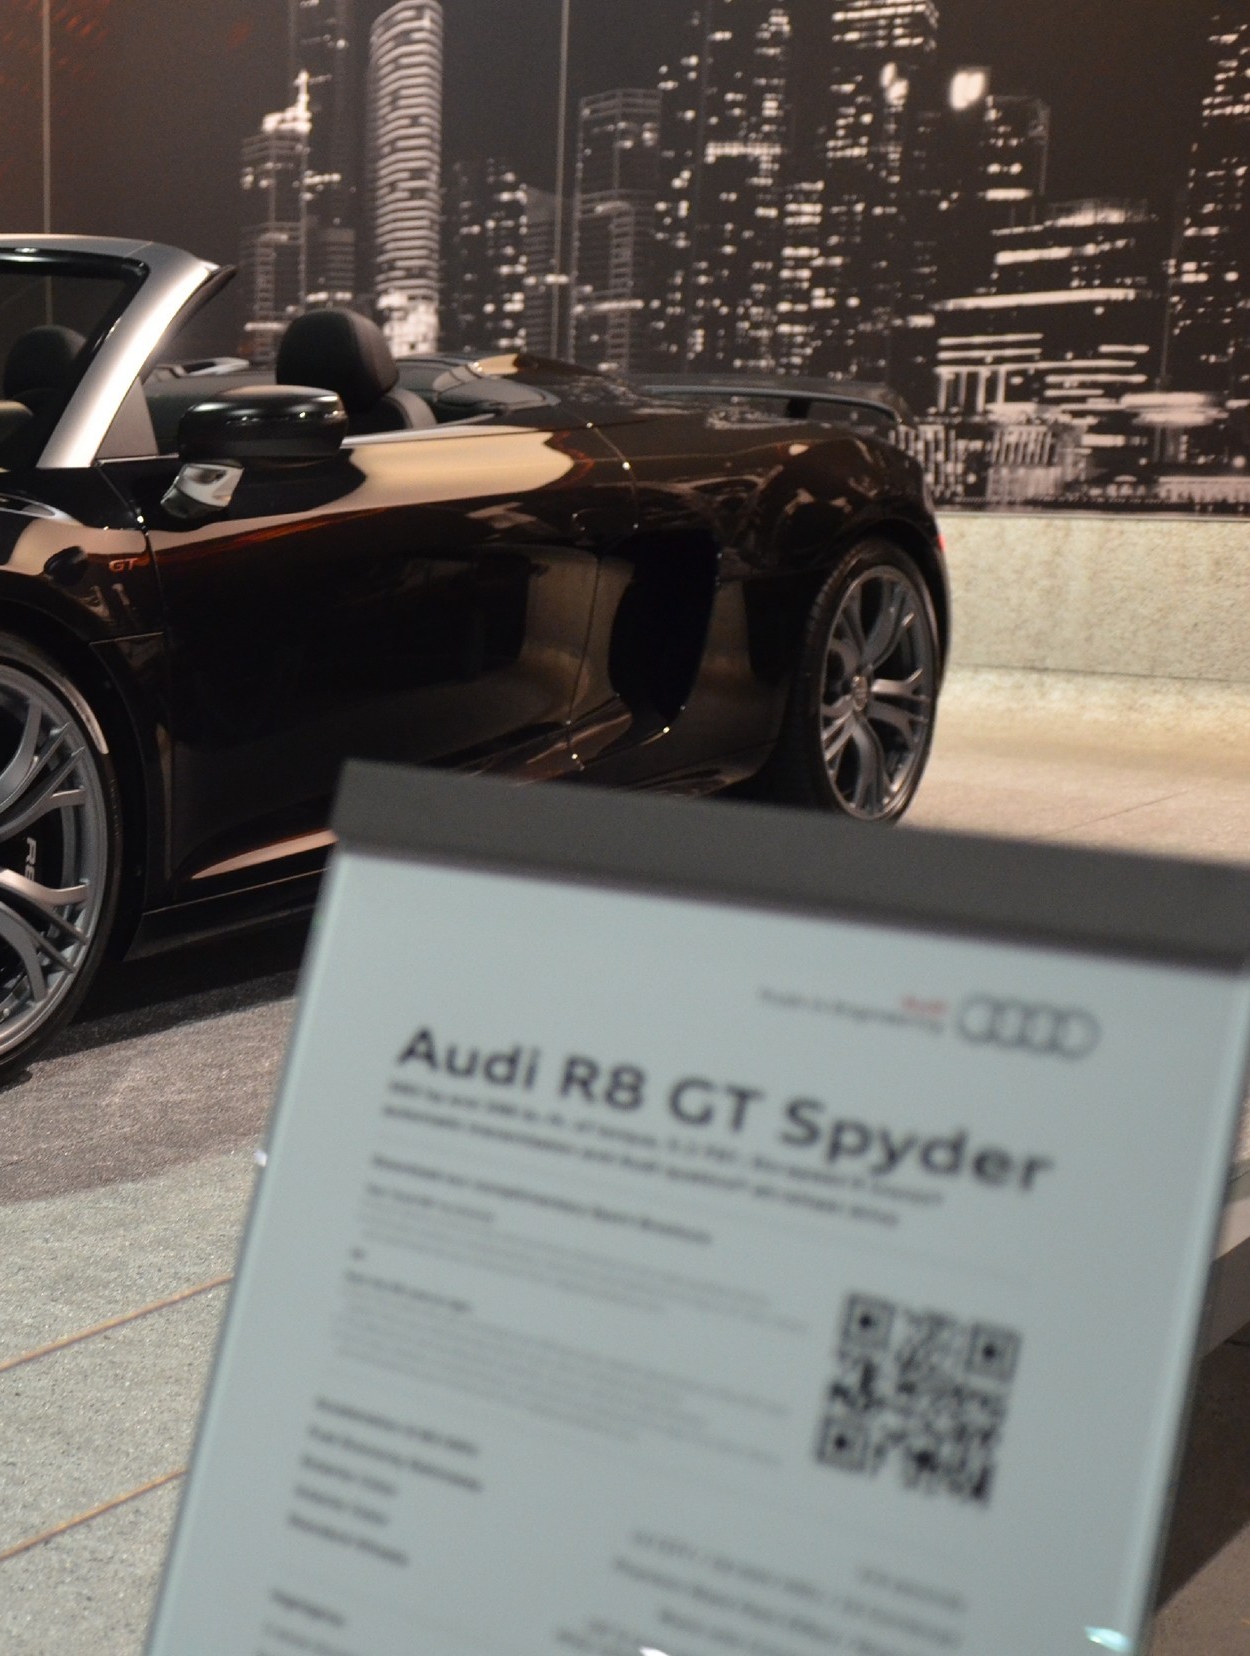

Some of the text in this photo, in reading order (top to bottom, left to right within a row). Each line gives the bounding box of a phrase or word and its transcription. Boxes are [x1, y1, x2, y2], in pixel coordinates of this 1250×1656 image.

[109, 557, 139, 571] GT
[398, 1026, 540, 1092] Audi
[558, 1055, 647, 1113] R8
[668, 1077, 764, 1132] GT
[779, 1095, 1054, 1191] Spyder
